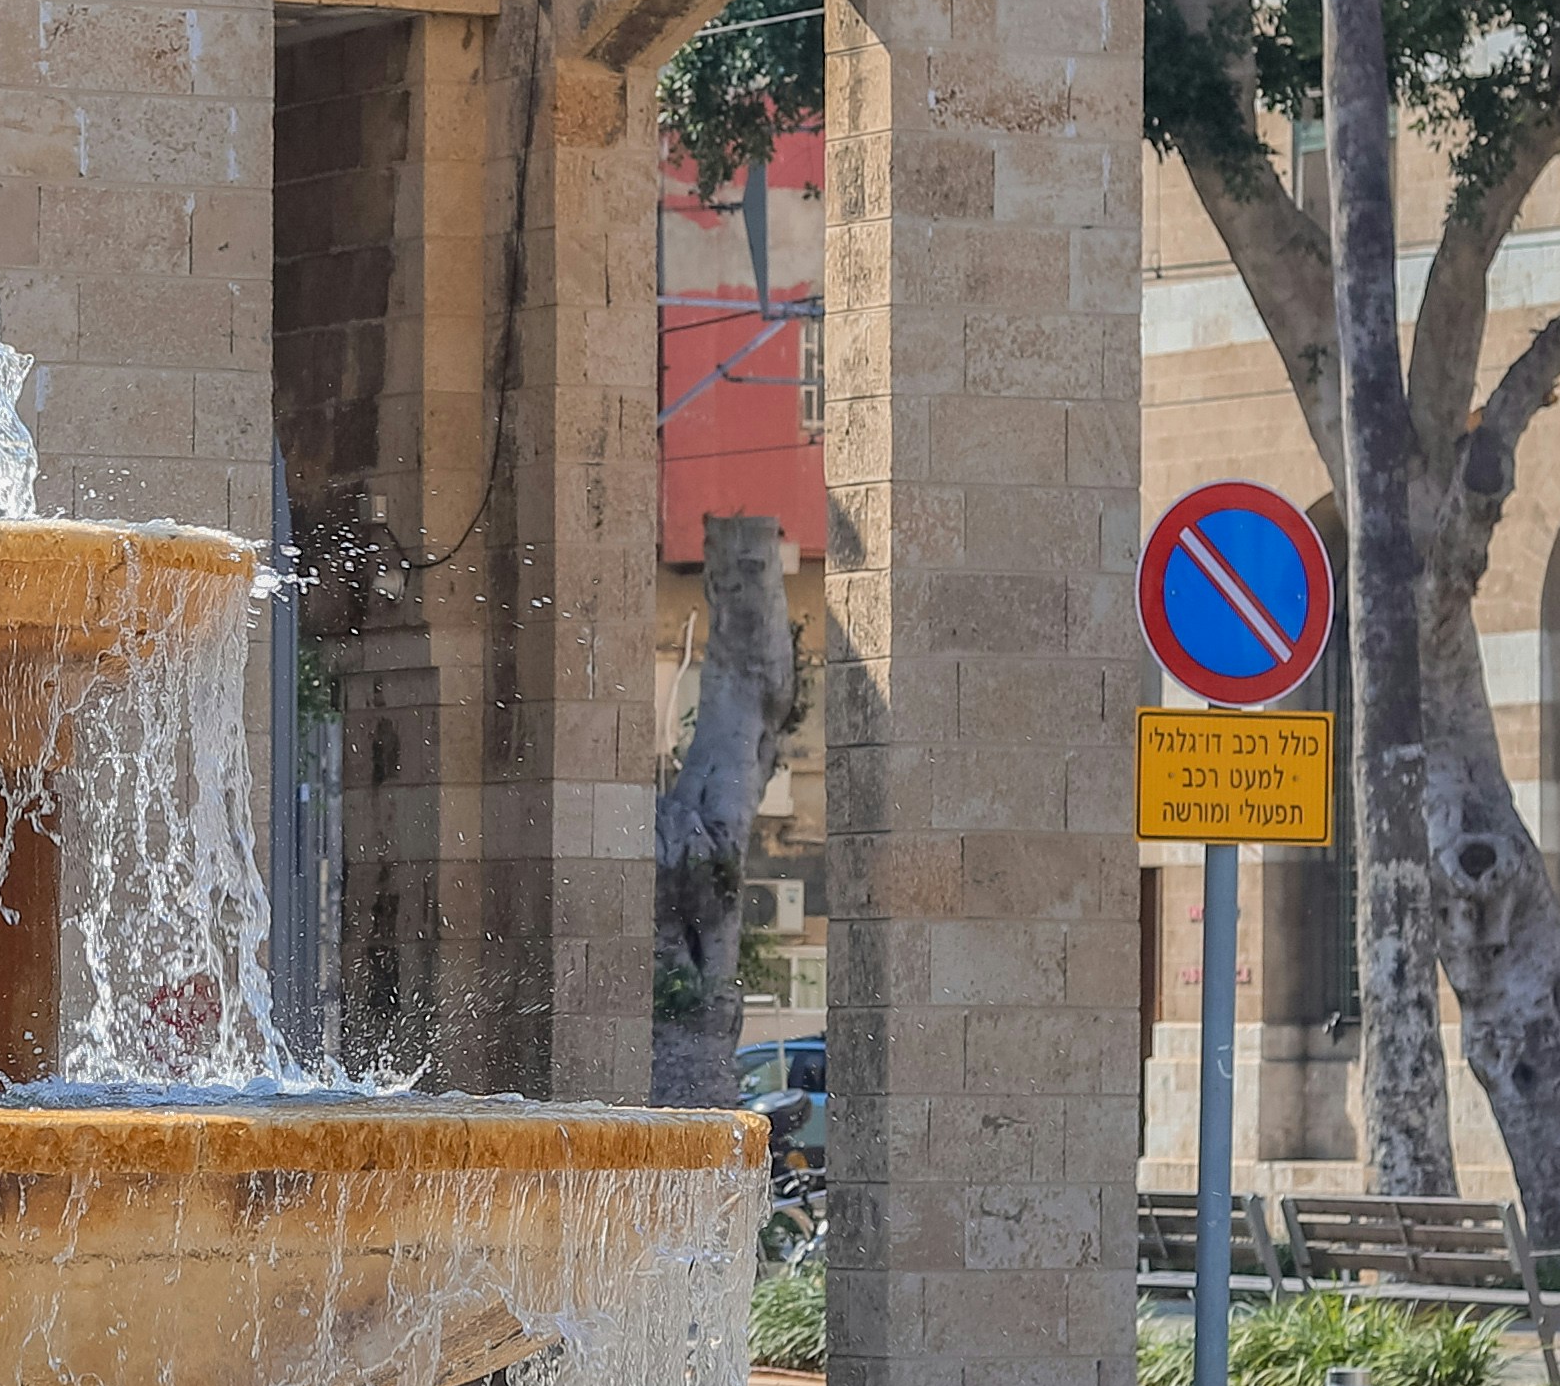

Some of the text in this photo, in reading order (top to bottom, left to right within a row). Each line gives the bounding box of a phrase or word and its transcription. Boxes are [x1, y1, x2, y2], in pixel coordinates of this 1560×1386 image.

[1232, 734, 1268, 755] רכב
[1278, 729, 1319, 756] כולל
[1182, 764, 1284, 792] למעט רכב
[1162, 799, 1303, 827] תפעולי ומורשה
